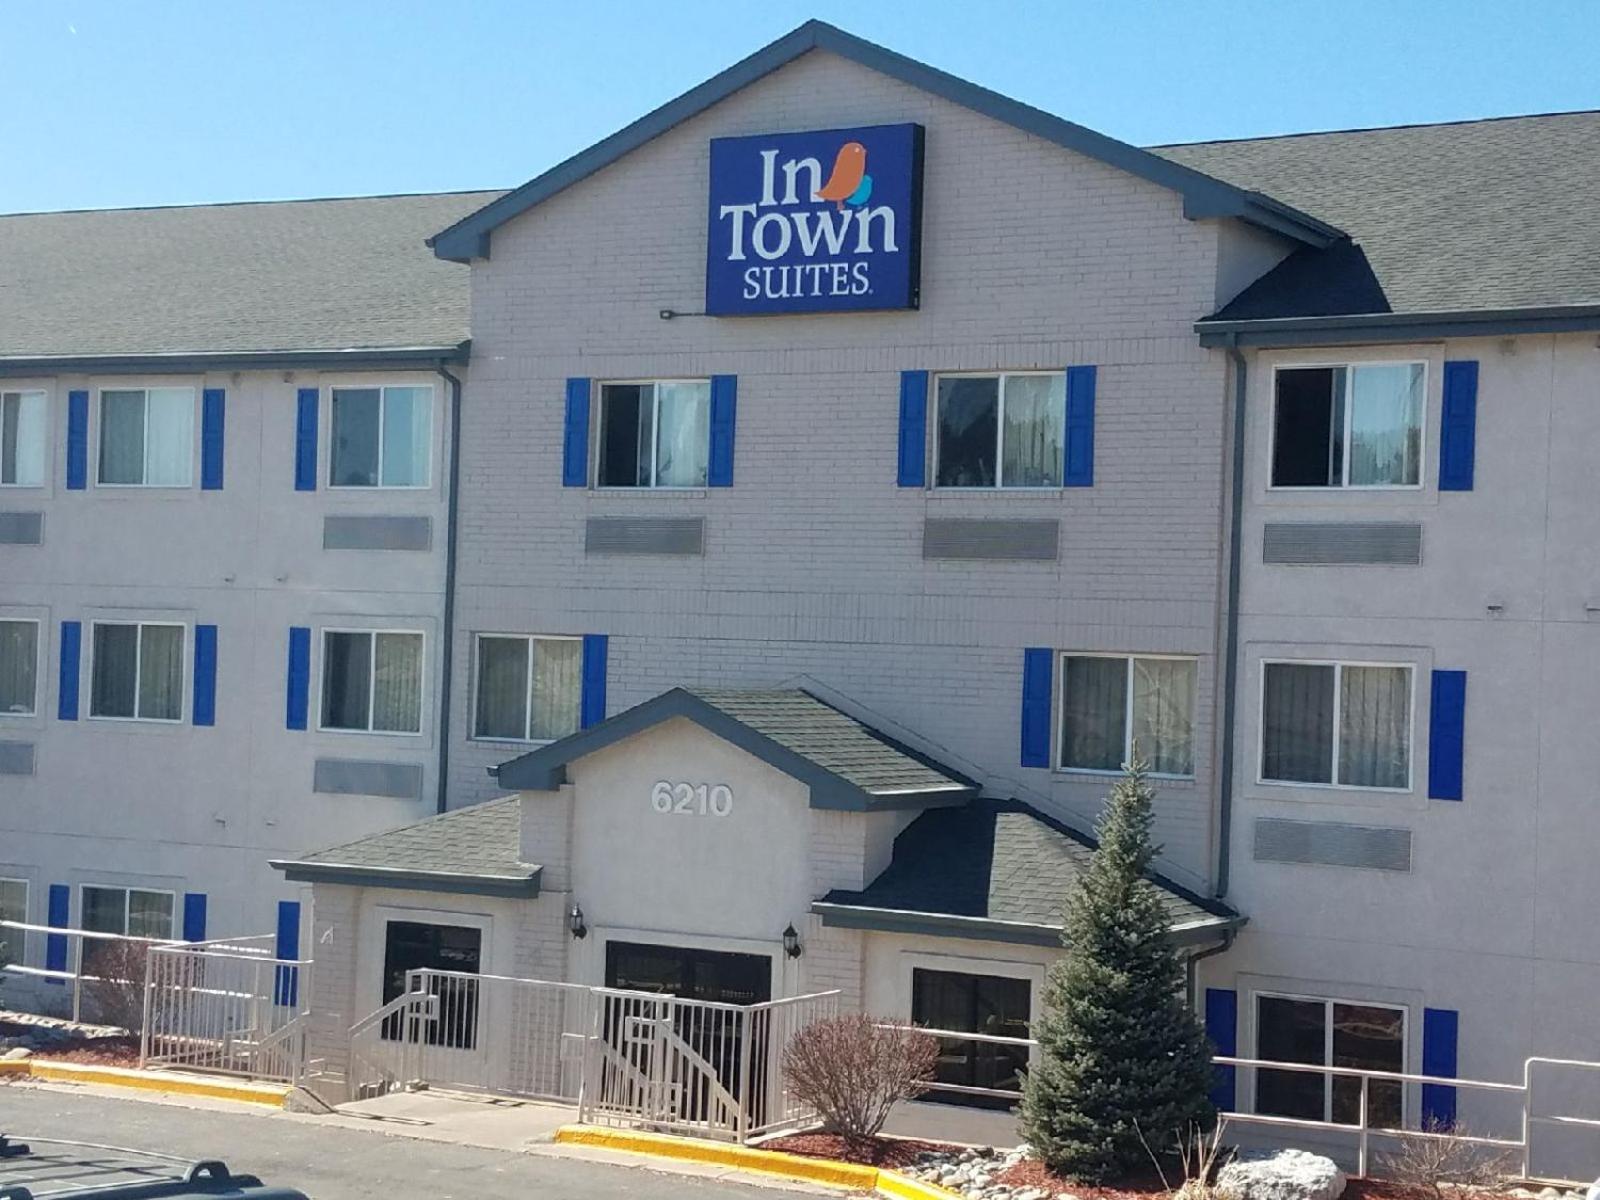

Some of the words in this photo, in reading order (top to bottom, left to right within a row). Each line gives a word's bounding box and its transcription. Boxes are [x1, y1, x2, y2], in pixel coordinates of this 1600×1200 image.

[760, 149, 825, 206] In
[719, 202, 899, 261] Town
[743, 261, 870, 300] SUITES
[651, 781, 733, 817] 6210
